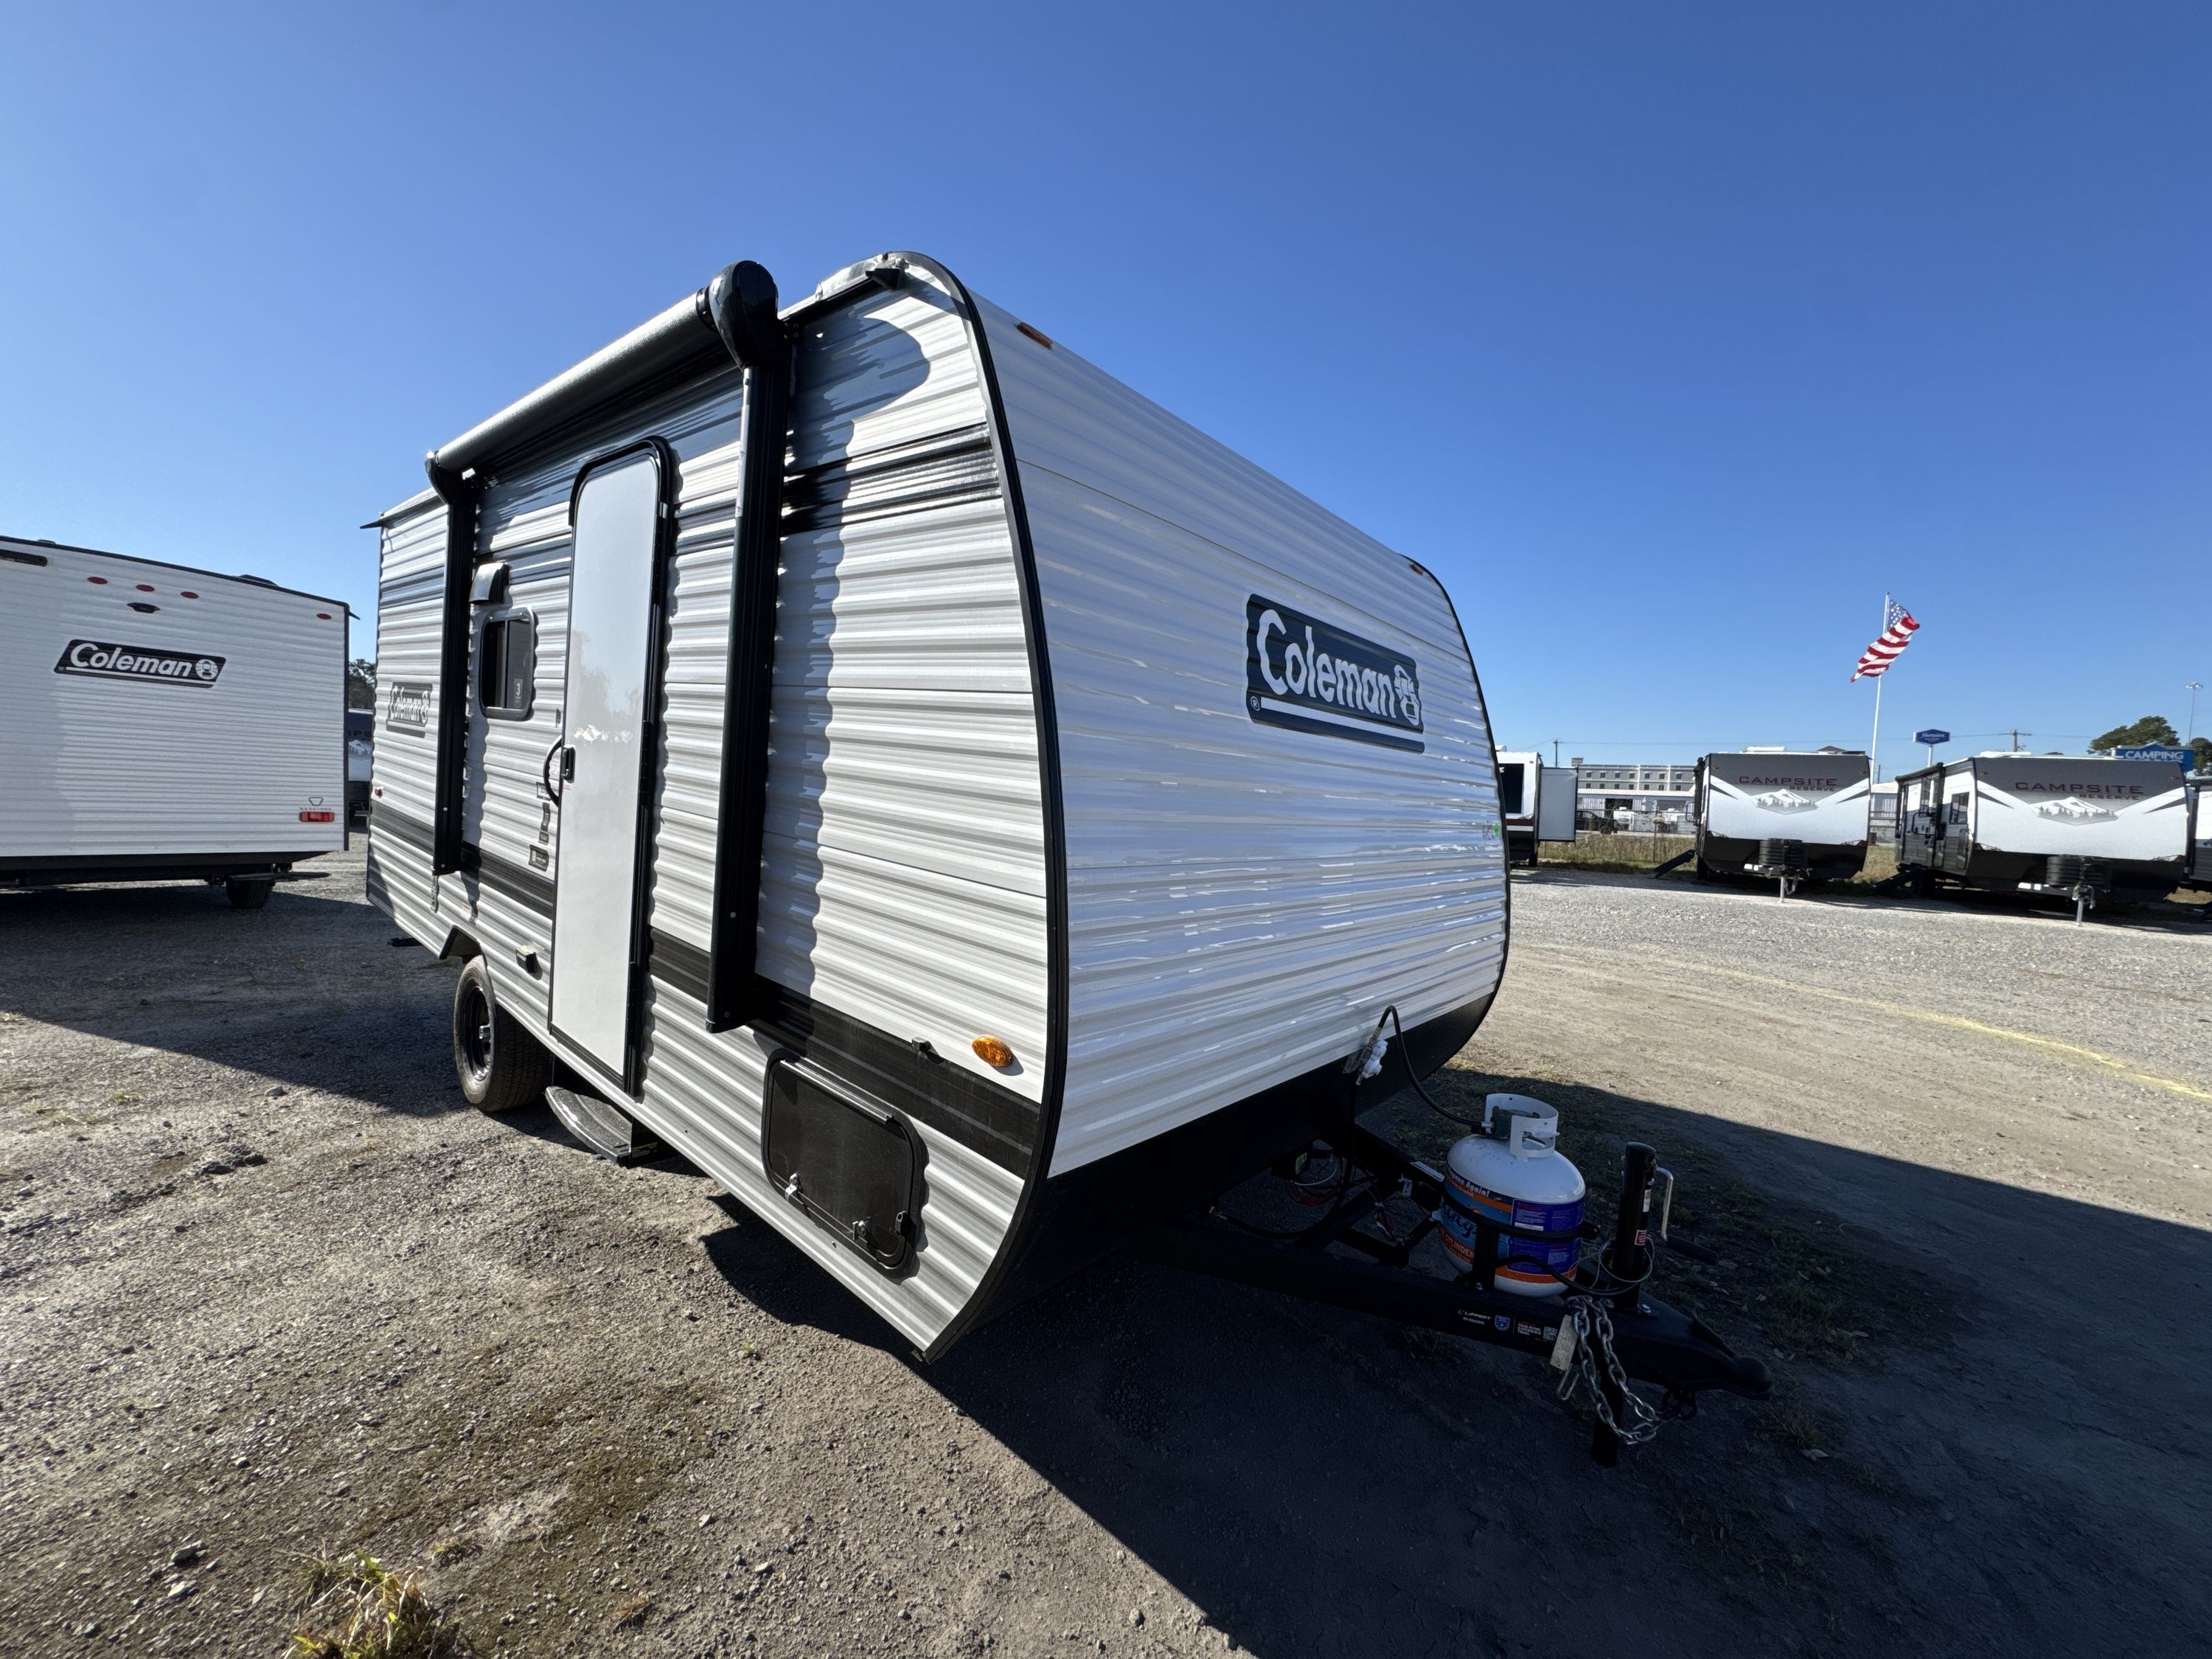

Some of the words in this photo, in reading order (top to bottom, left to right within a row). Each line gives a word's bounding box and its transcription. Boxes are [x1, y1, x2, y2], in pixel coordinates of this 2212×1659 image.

[71, 643, 192, 677] Coleman
[1257, 609, 1397, 718] Coleman
[516, 683, 521, 696] 3
[390, 685, 422, 722] Coleman
[2125, 751, 2184, 759] CAMPING
[1739, 776, 1837, 786] CAMPSITE
[2015, 782, 2143, 794] CAMPSITE
[1465, 1180, 1490, 1198] Again!
